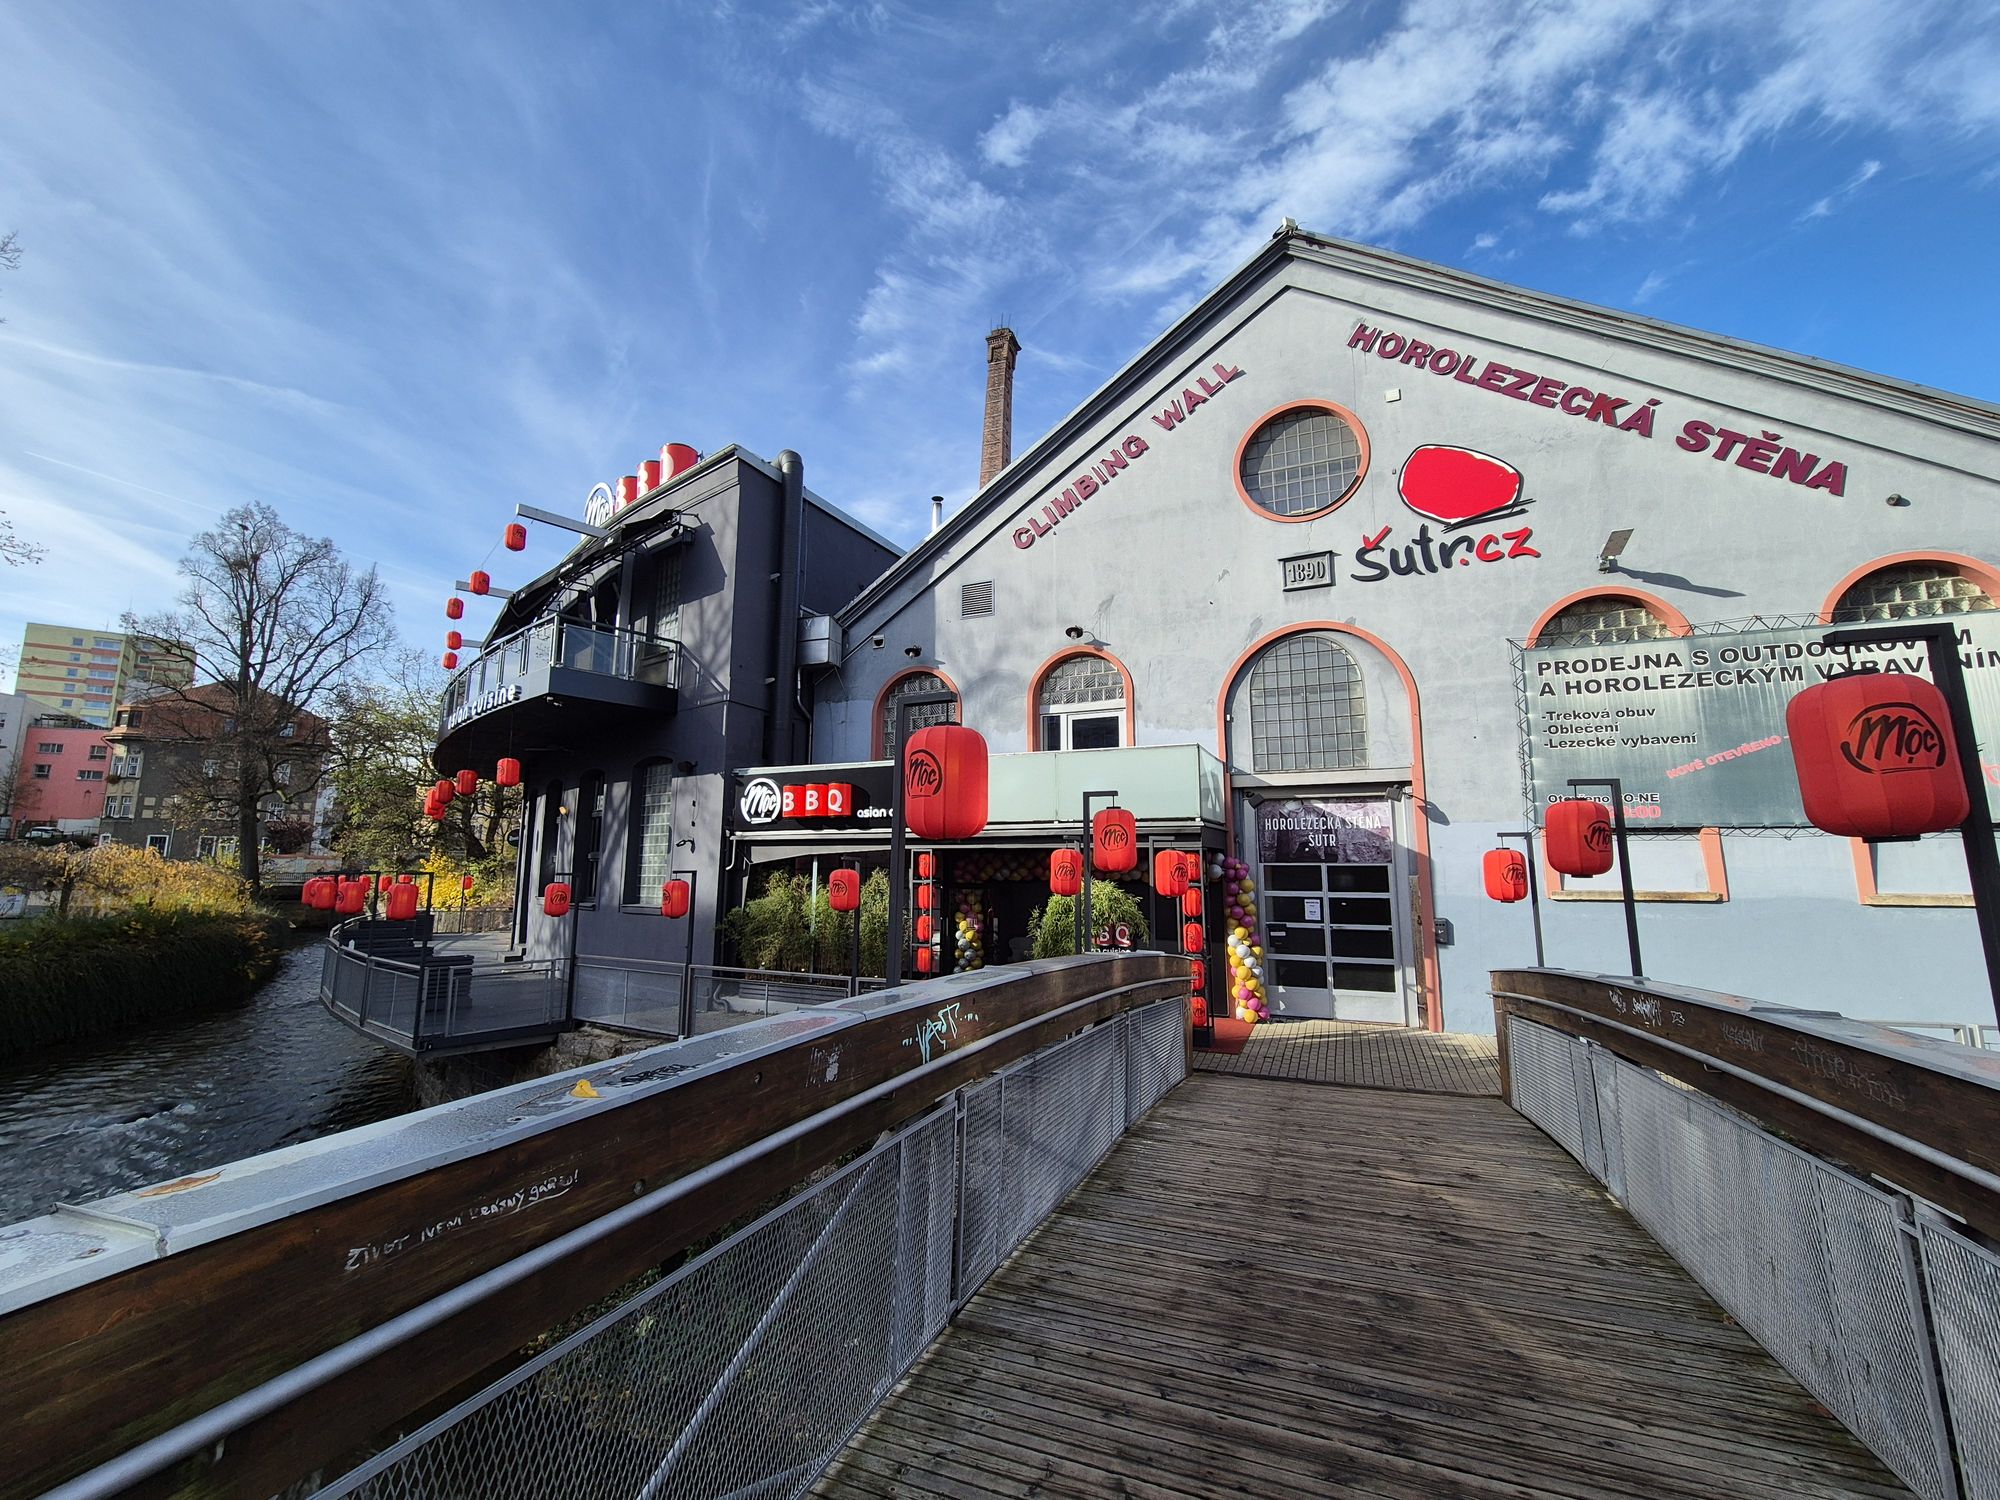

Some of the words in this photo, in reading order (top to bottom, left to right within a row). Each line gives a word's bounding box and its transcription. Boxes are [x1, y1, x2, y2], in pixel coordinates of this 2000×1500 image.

[1347, 322, 1661, 438] HOROLEZECKÁ
[1675, 420, 1848, 497] STĚNA
[1012, 435, 1150, 549] CLIMBING
[1151, 363, 1241, 431] WALL
[1288, 561, 1326, 583] 1890
[1537, 653, 1682, 676] PRODEJNA
[1692, 650, 1709, 666] S
[1719, 629, 1973, 663] OUTDOOROVM
[1539, 682, 1556, 697] A
[1565, 663, 1803, 695] HOROLEZECKÝM
[471, 682, 516, 716] cuisine
[1541, 708, 1610, 721] -Treková
[1616, 707, 1656, 718] obuv
[1542, 722, 1619, 735] -Oblečení
[1543, 735, 1616, 749] -Lezecké
[1621, 733, 1697, 749] vybavení
[1666, 759, 1705, 779] NOVĚ
[1706, 735, 1781, 765] OTEVŘENO
[856, 805, 887, 818] asian
[1308, 831, 1337, 847] ŠUTR
